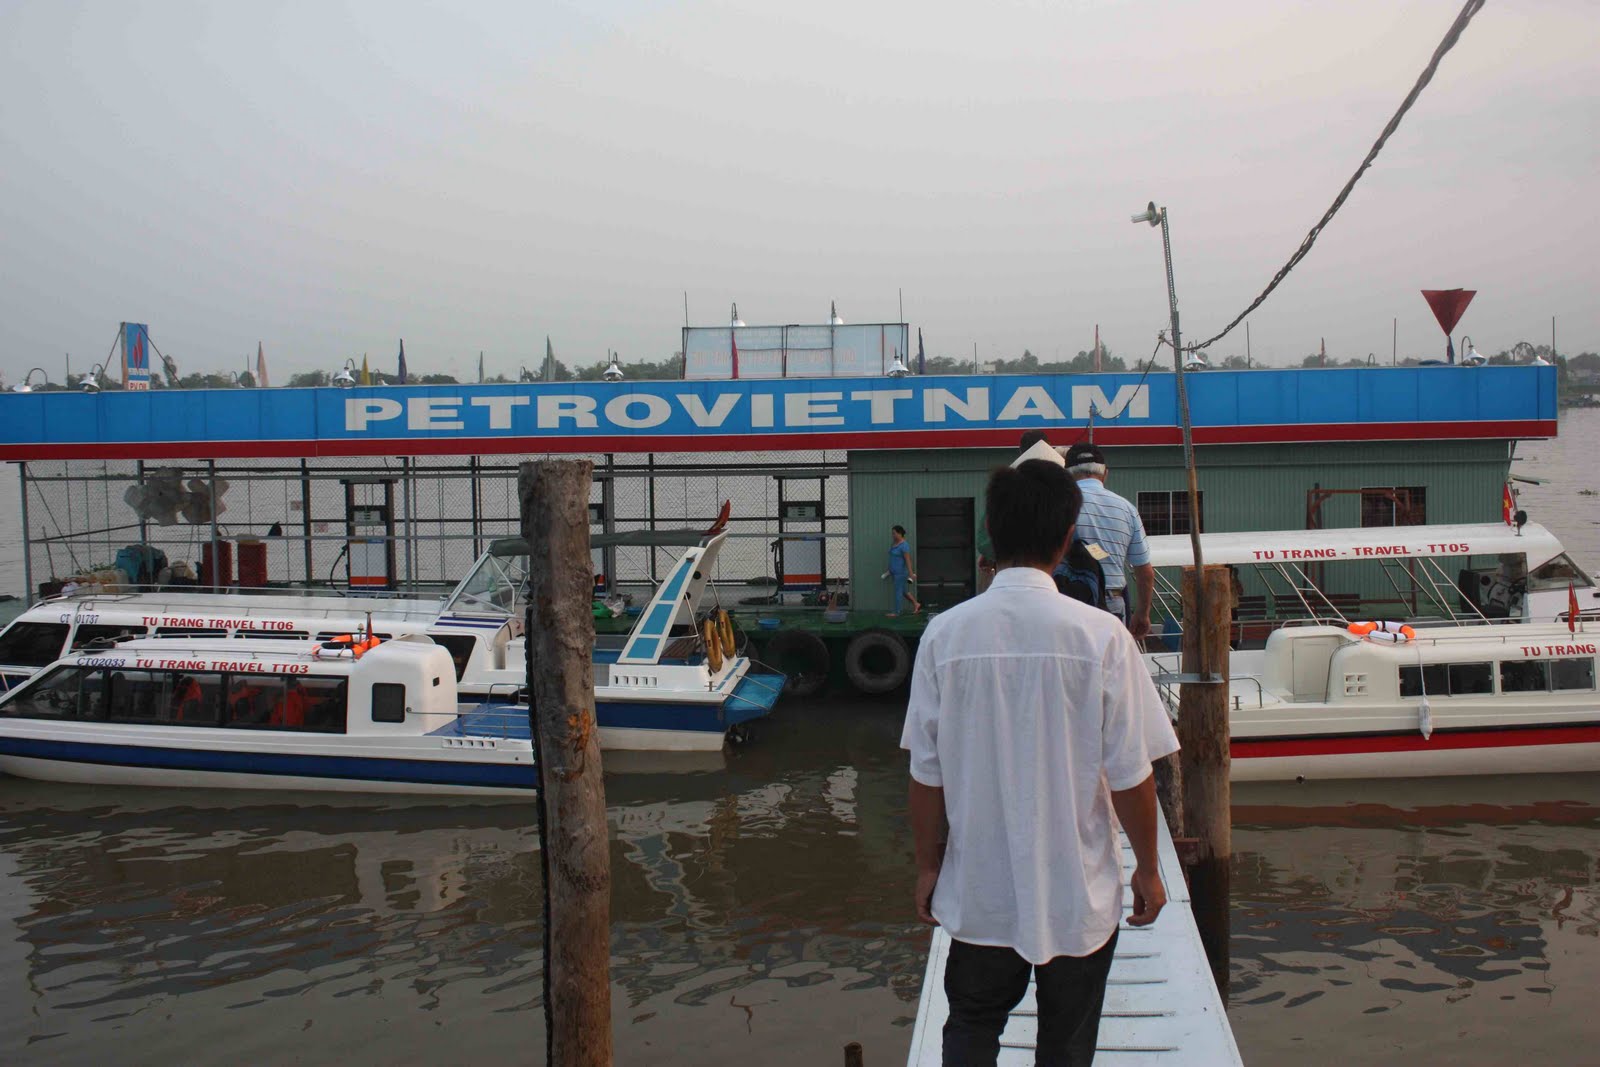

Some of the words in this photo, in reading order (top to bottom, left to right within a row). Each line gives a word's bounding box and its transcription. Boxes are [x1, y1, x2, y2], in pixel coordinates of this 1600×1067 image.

[345, 384, 1150, 431] PETROVIETNAM
[1253, 550, 1275, 560] TU
[1280, 548, 1336, 559] TRANG
[1352, 545, 1411, 556] TRAVEL
[1427, 543, 1470, 553] TT05
[60, 614, 71, 624] CT
[76, 615, 100, 625] 01737
[142, 616, 158, 626] TU
[162, 618, 204, 628] TRANG
[208, 619, 256, 630] TRAVEL
[261, 620, 294, 631] TT06
[1520, 646, 1541, 657] TU
[1545, 644, 1597, 656] TRANG
[135, 658, 154, 668] TU
[159, 660, 206, 671] TRANG
[211, 662, 265, 673] TRAVEL
[272, 664, 309, 674] TT03
